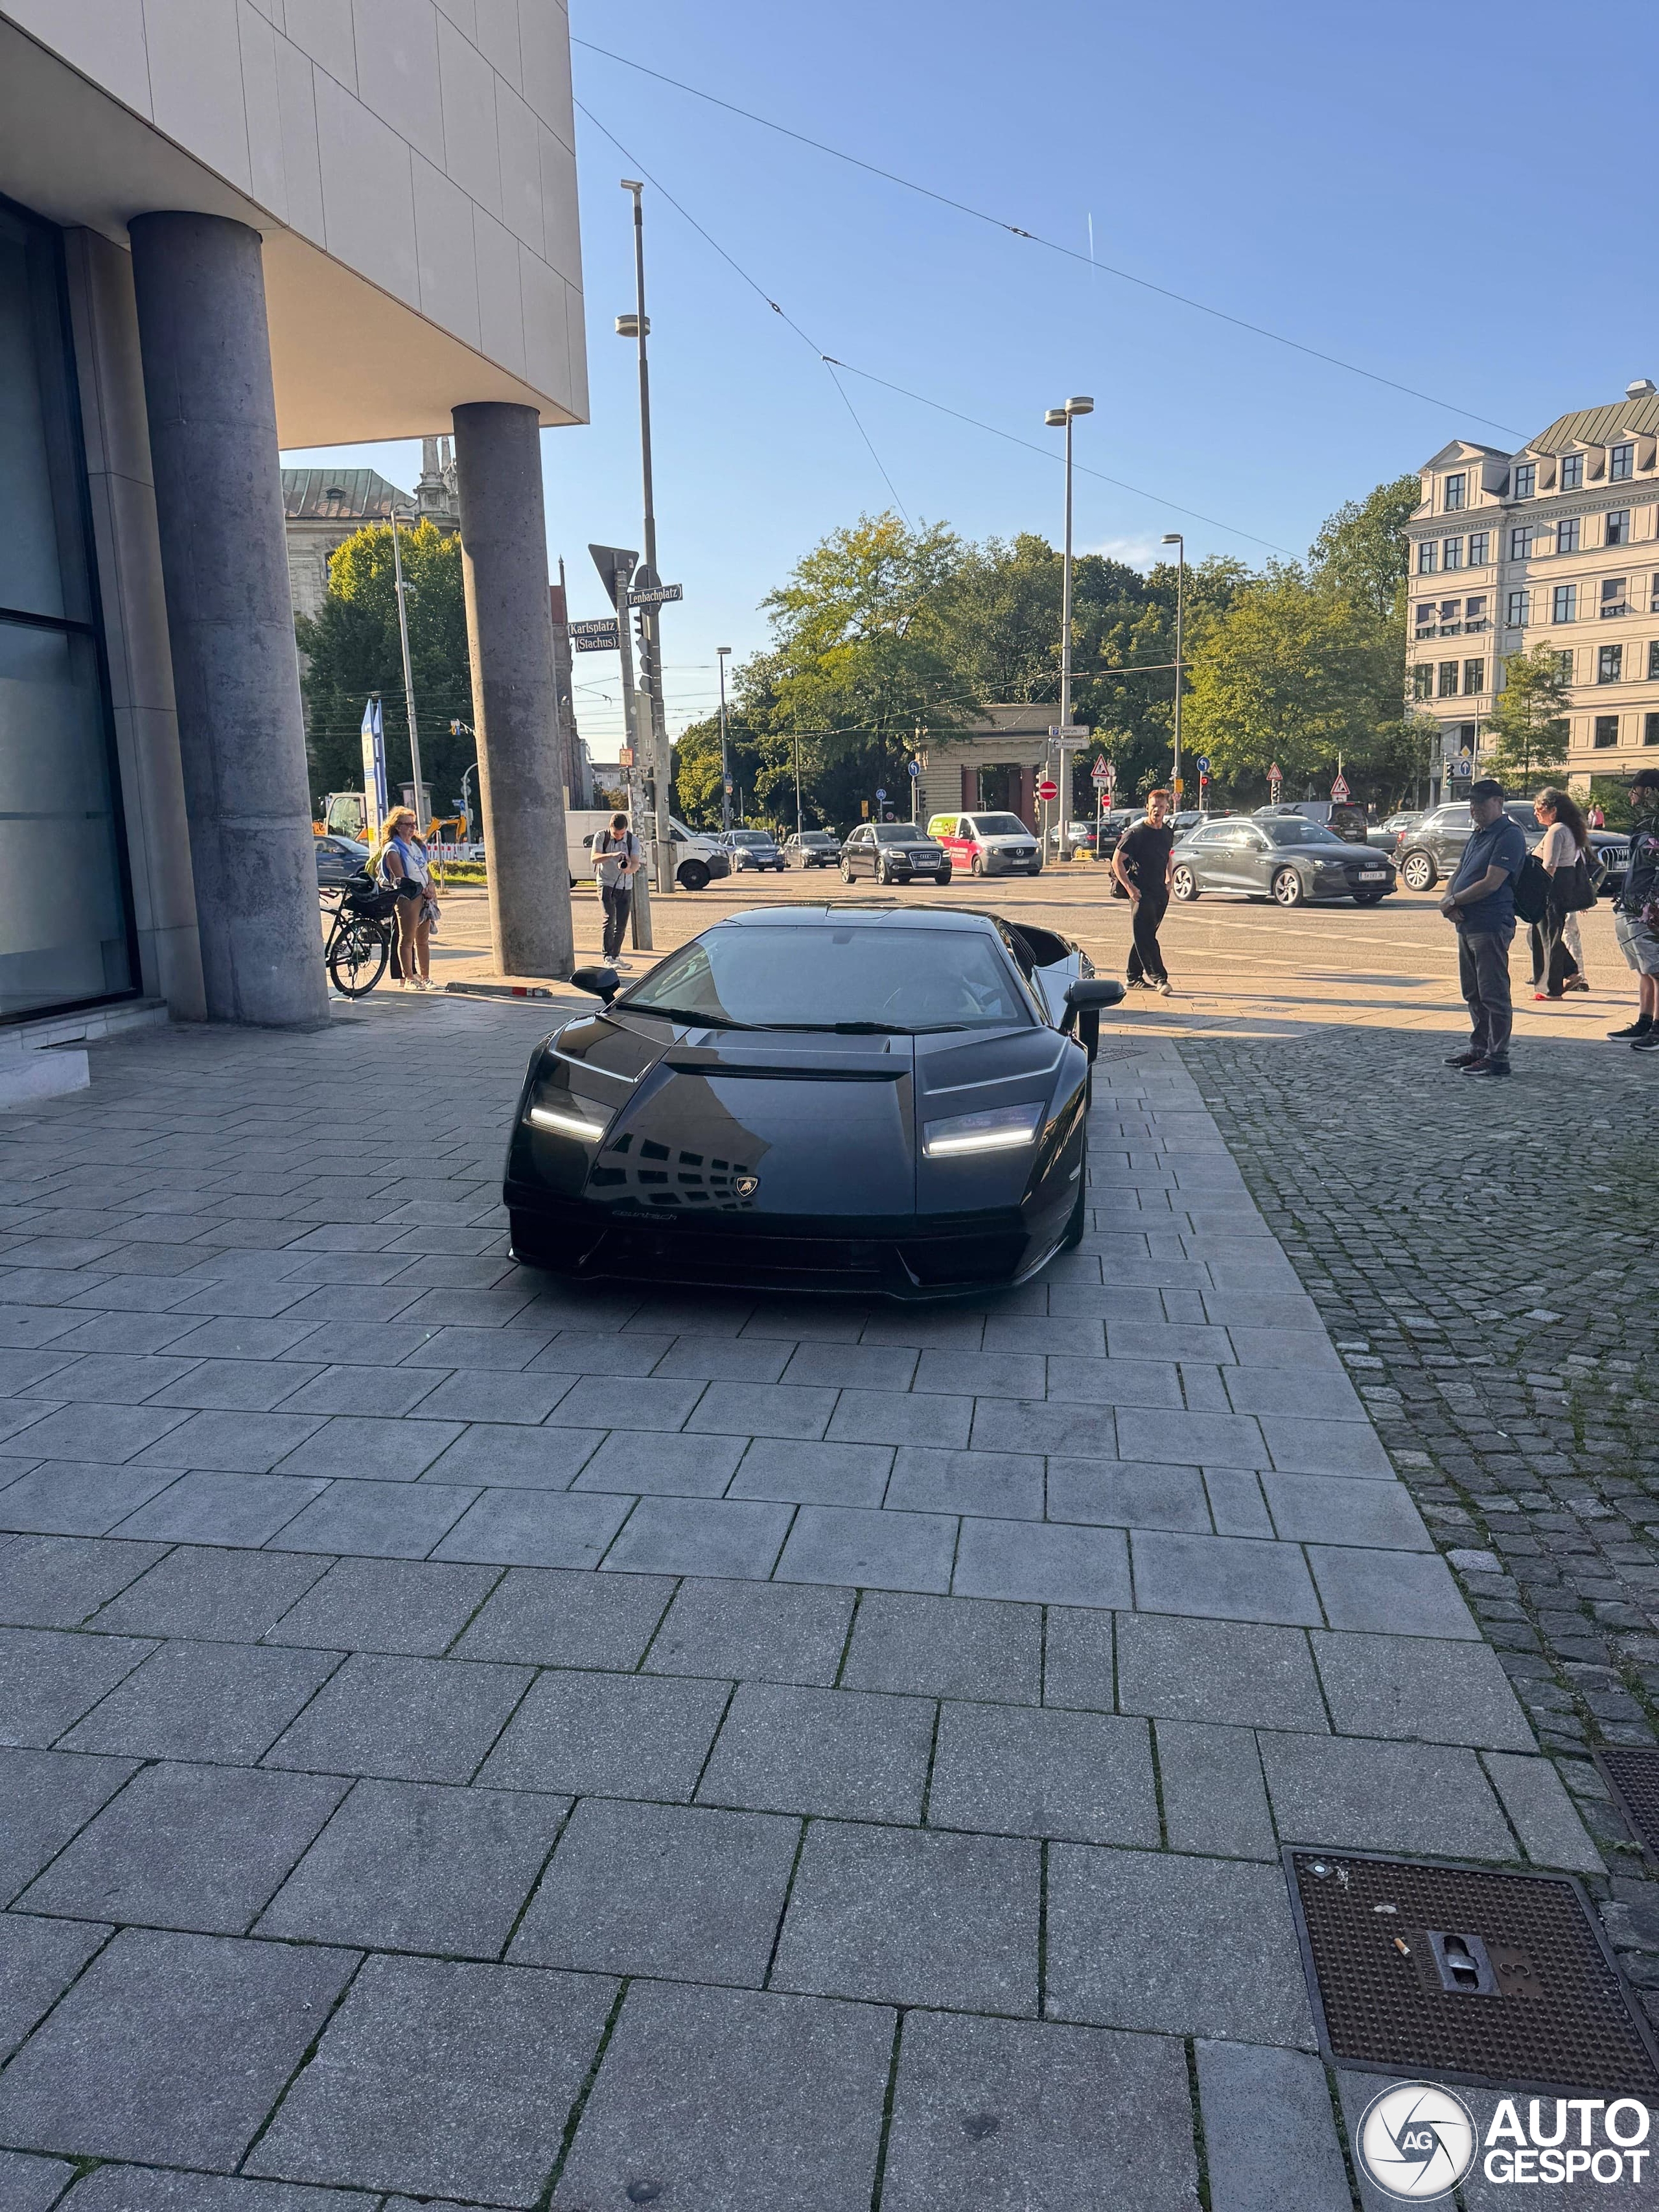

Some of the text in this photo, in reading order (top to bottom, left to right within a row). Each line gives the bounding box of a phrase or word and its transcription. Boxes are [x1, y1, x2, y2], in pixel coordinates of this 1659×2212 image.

[629, 588, 678, 605] Lenbachplatz
[570, 621, 615, 635] Karlsplatz
[576, 636, 616, 651] (Stachus)
